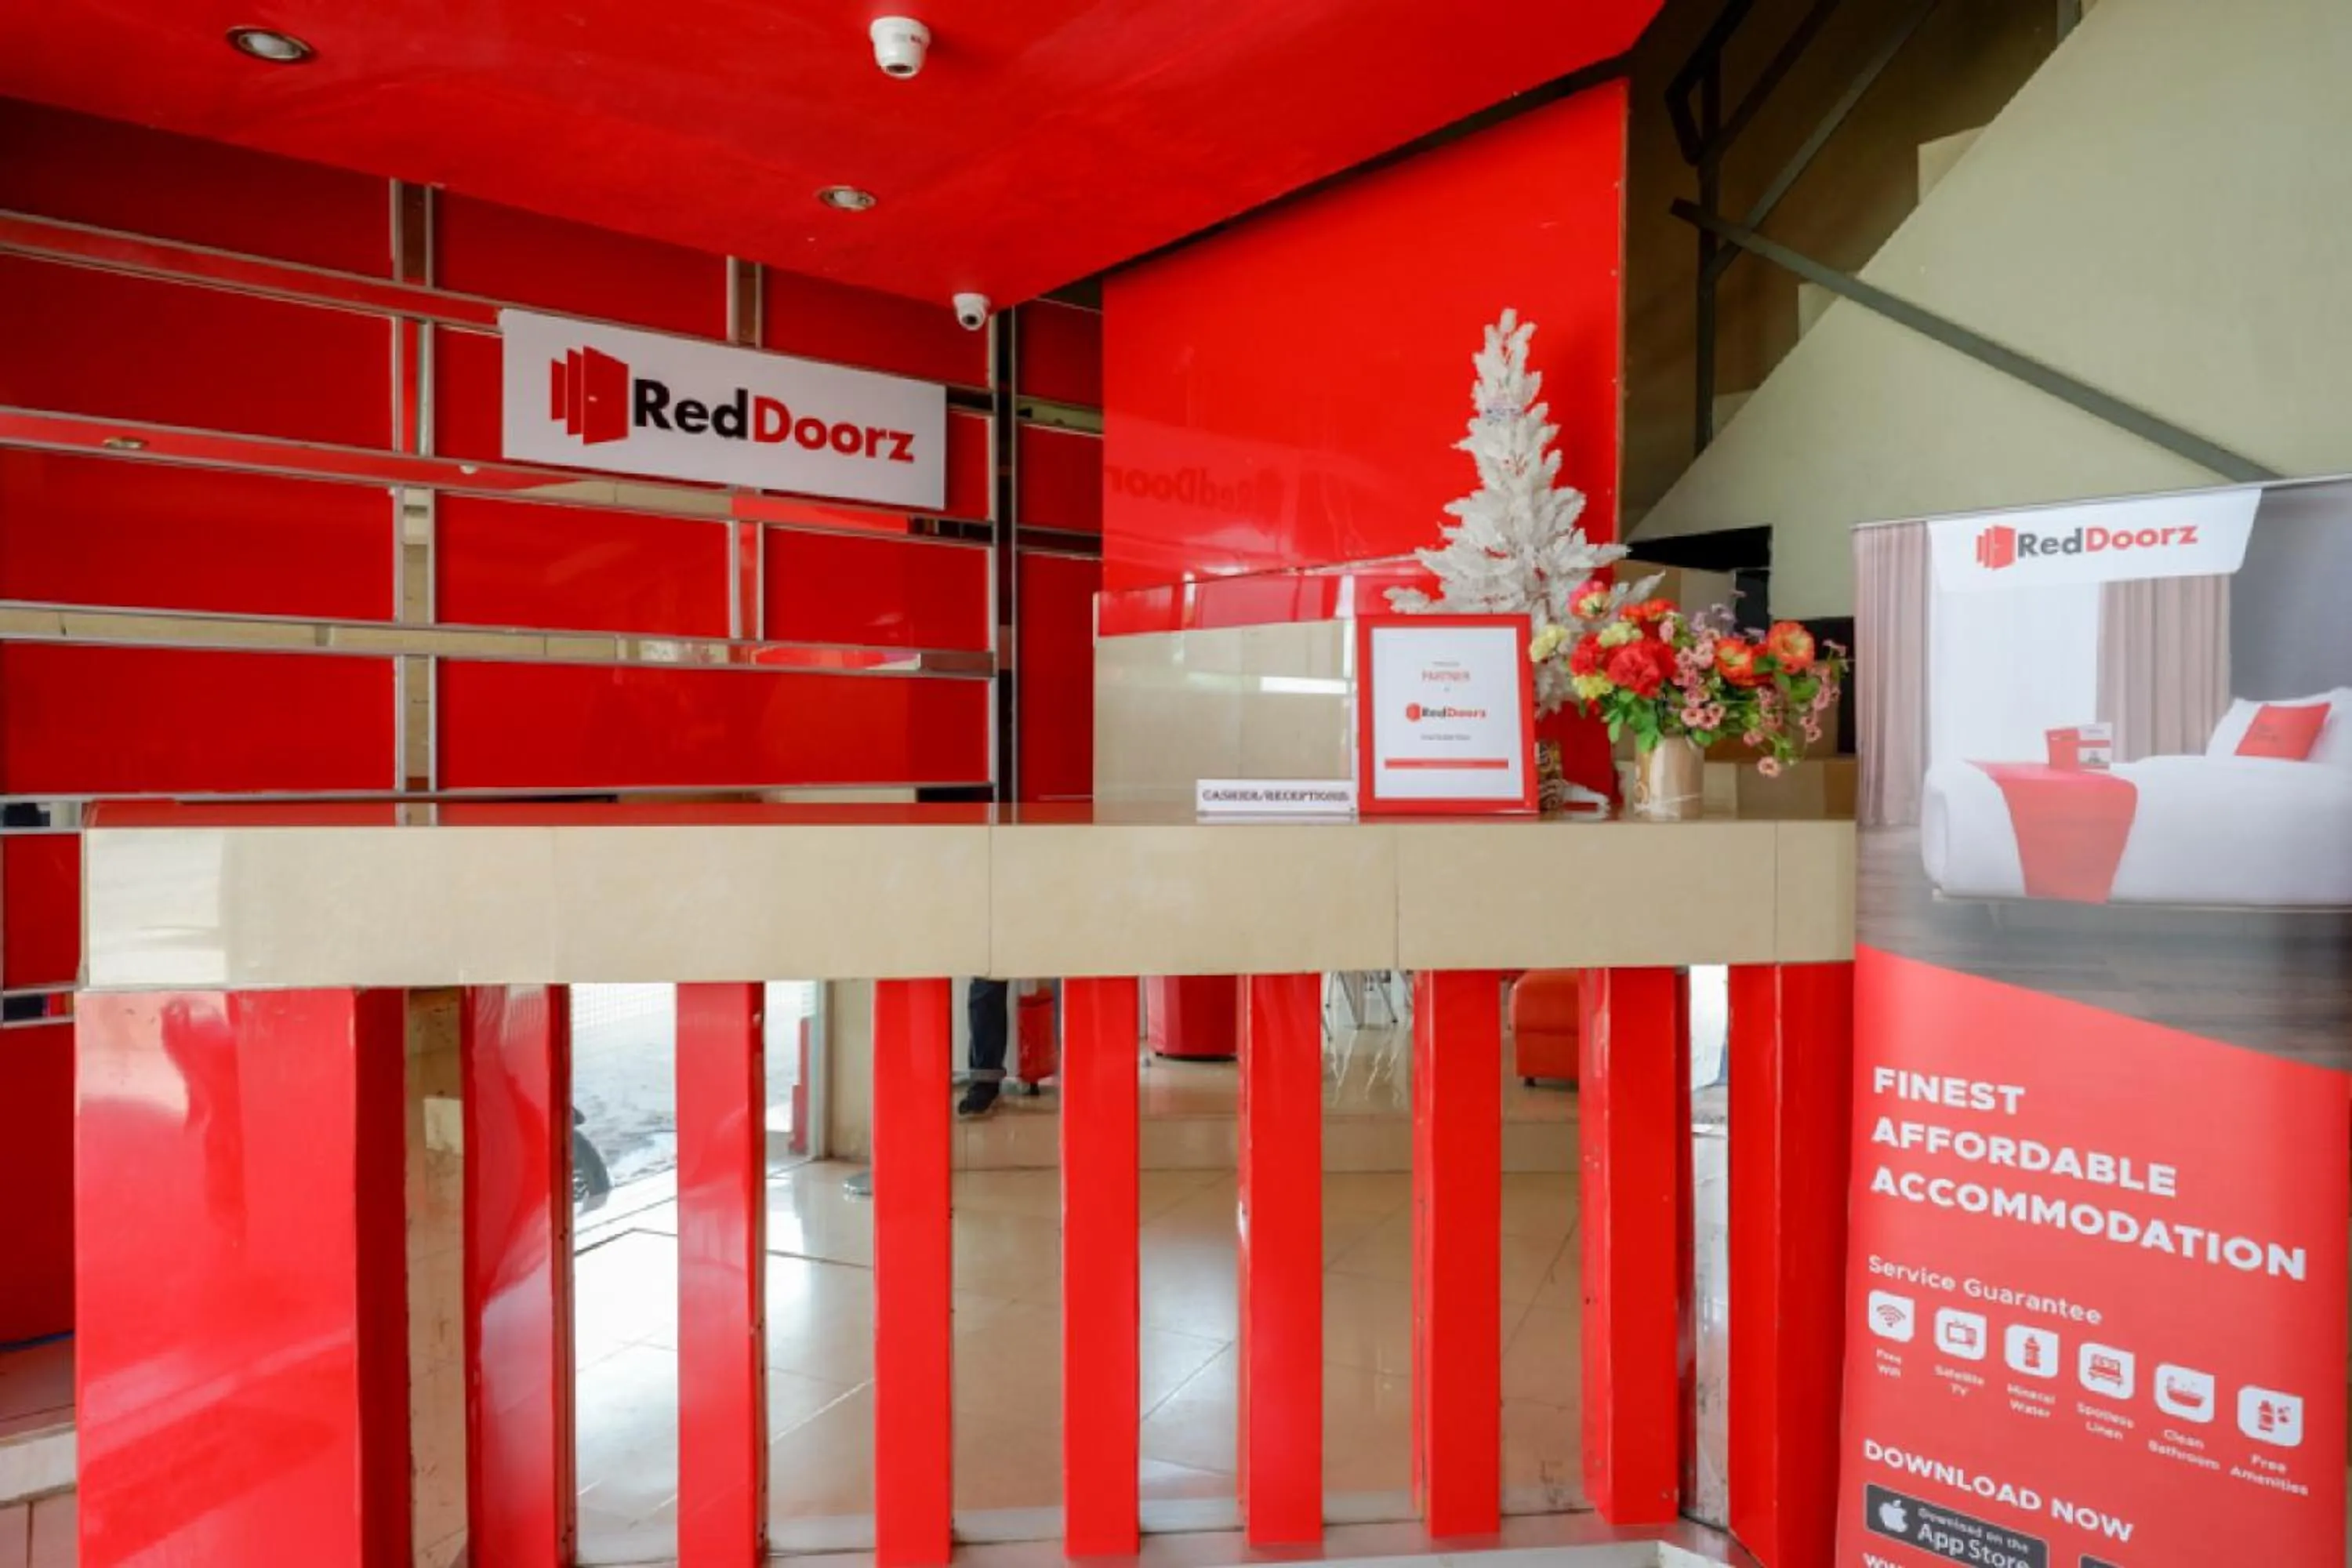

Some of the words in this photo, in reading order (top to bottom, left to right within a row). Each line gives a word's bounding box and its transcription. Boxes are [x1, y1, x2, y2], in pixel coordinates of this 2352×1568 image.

[633, 377, 915, 463] RedDoorz
[2016, 524, 2199, 558] RedDoorz
[1421, 706, 1486, 720] RedDoorz
[1875, 1067, 2026, 1115] FINEST
[1872, 1116, 2176, 1197] AFFORDABLE
[1871, 1166, 2305, 1279] ACCOMMODATION
[1869, 1254, 1956, 1292] Service
[1962, 1277, 2103, 1325] Guarantee
[1876, 1348, 1902, 1365] Free
[1951, 1383, 1969, 1396] TV
[2006, 1383, 2056, 1404] Mineral
[2009, 1399, 2051, 1417] Water
[2077, 1402, 2134, 1428] Spotless
[2085, 1421, 2123, 1439] Linen
[2163, 1428, 2205, 1449] Clean
[2147, 1439, 2220, 1470] Bathroom
[2251, 1454, 2287, 1473] Free
[1864, 1439, 2042, 1510] DOWNLOAD
[2051, 1497, 2133, 1542] NOW
[2230, 1465, 2308, 1495] Amenities
[1917, 1523, 1965, 1556] App
[1968, 1538, 2031, 1568] Store
[1918, 1507, 1983, 1538] Download
[1986, 1531, 2003, 1545] on
[2006, 1537, 2029, 1554] the
